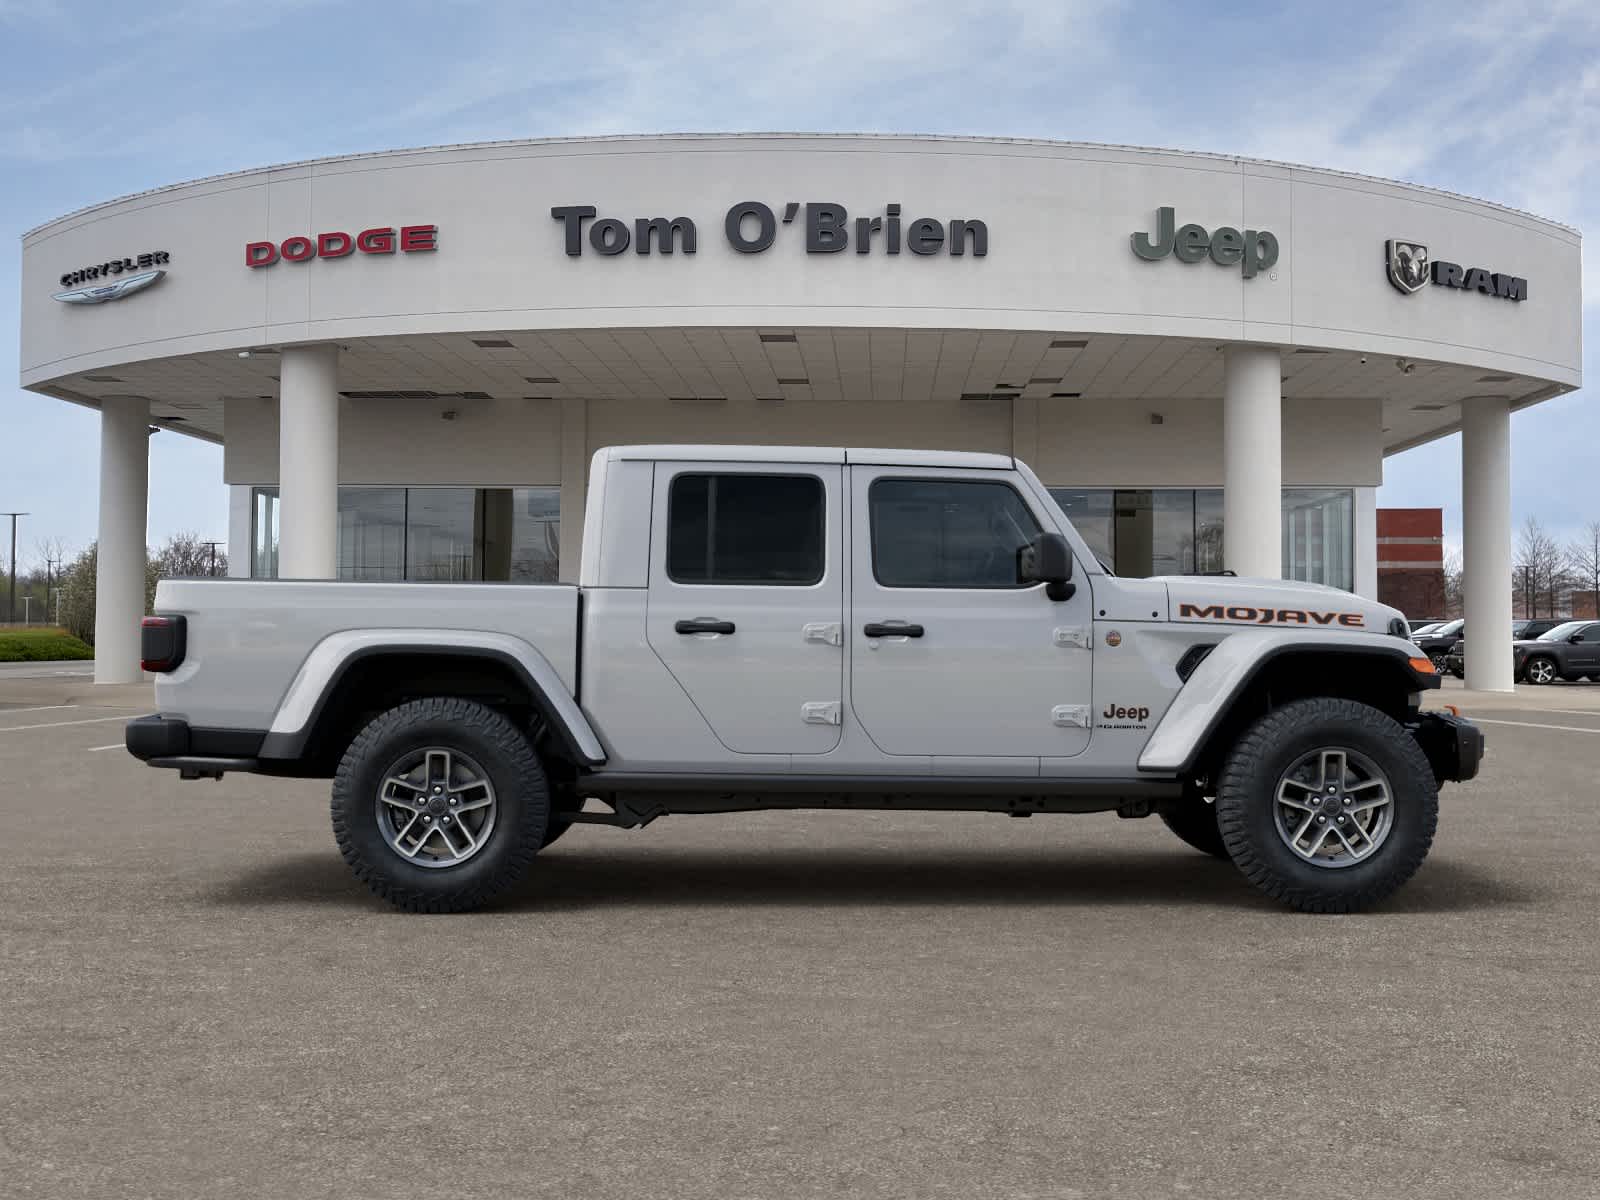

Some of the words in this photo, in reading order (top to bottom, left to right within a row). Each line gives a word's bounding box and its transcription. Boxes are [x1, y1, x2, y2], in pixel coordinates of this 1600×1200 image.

[245, 224, 438, 269] DODGE
[551, 205, 697, 256] Tom
[725, 201, 988, 256] O'Brien
[1130, 206, 1279, 279] Jeep
[60, 249, 170, 287] CHRYSLER
[1431, 260, 1528, 302] RAM
[1179, 603, 1366, 628] MOJAVE
[1103, 703, 1150, 723] Jeep
